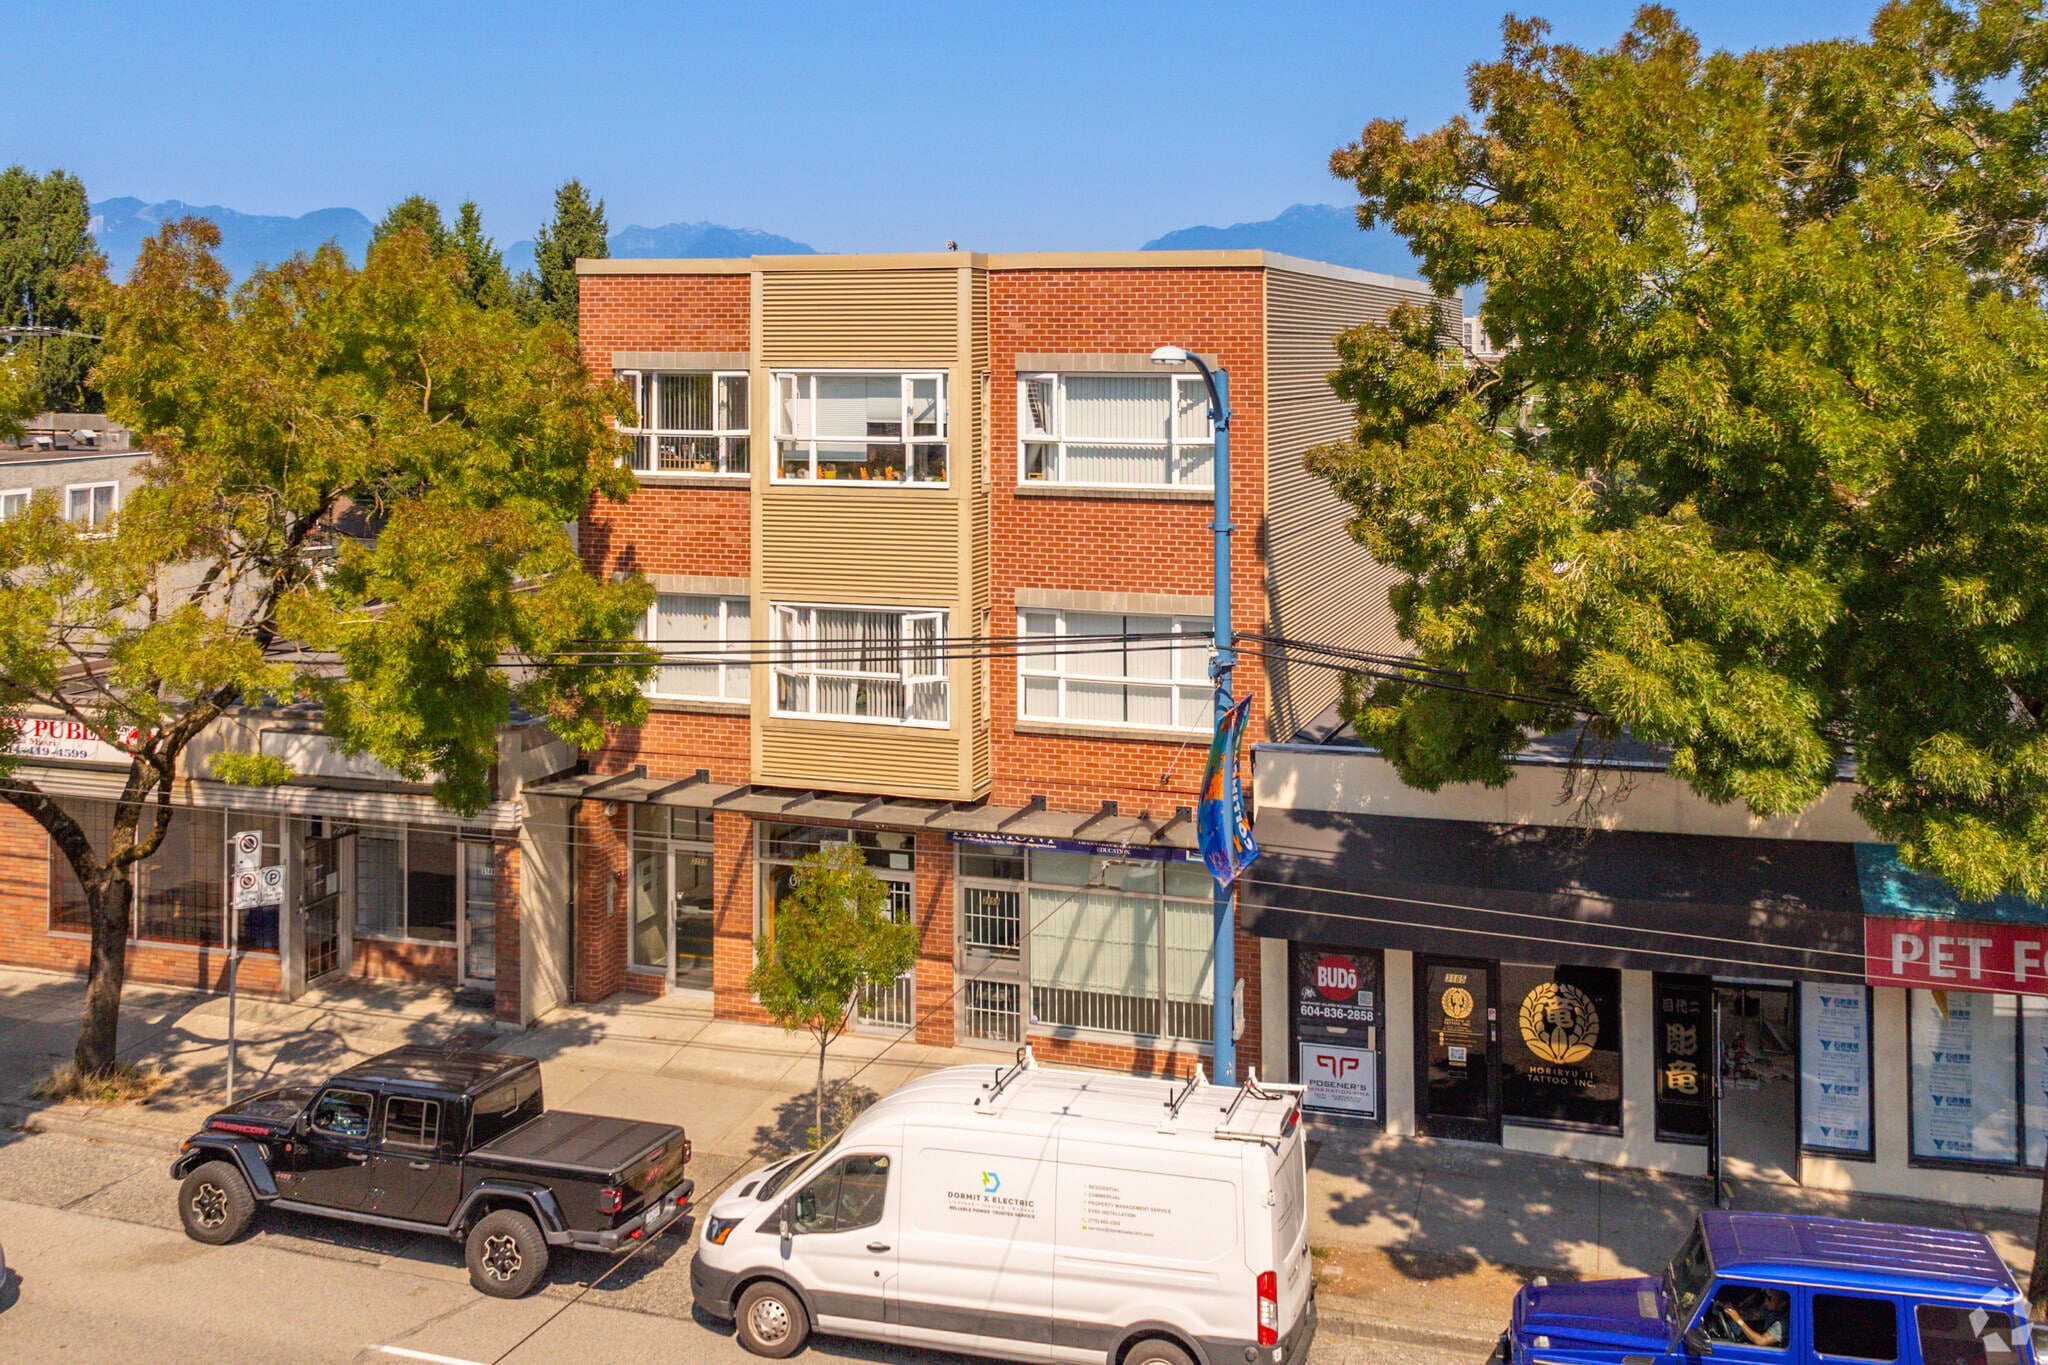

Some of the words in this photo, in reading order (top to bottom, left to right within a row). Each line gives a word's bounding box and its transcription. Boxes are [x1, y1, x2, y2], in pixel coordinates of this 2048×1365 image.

[34, 719, 110, 741] PUBL
[1892, 933, 1993, 980] PET
[2014, 940, 2048, 984] F
[1300, 1005, 1374, 1021] 604-836-2858
[1529, 1066, 1578, 1077] HORIRYU
[1309, 1079, 1367, 1091] POSENER'S
[1527, 1074, 1568, 1085] TATTOO
[1575, 1079, 1596, 1089] INC.
[947, 1191, 981, 1201] DORMIT
[992, 1196, 1035, 1207] ELECTRIC
[1088, 1200, 1114, 1208] PROPERTY
